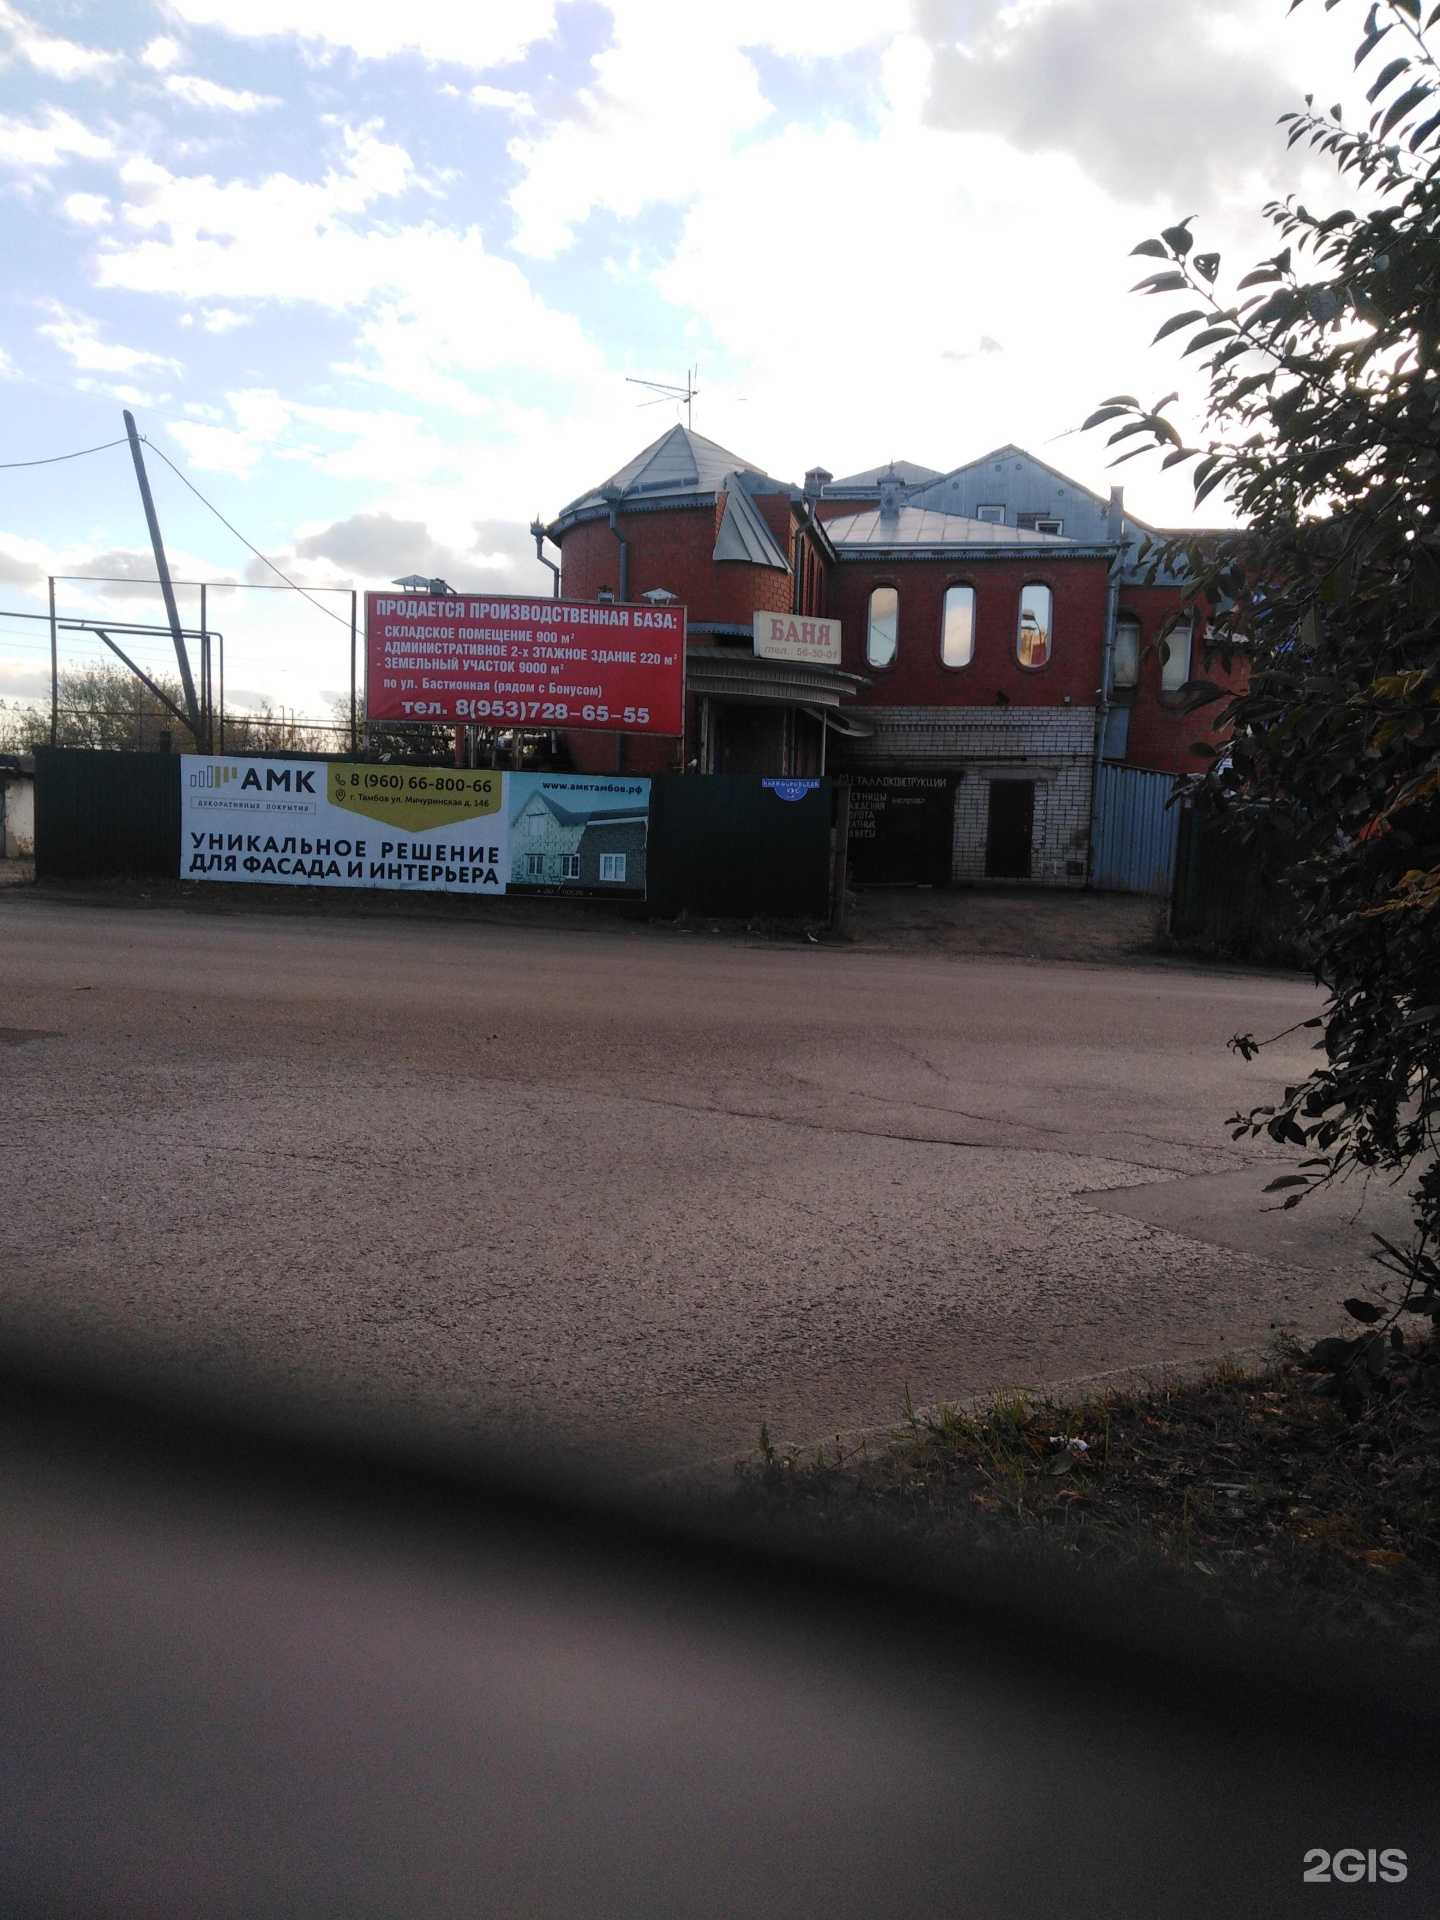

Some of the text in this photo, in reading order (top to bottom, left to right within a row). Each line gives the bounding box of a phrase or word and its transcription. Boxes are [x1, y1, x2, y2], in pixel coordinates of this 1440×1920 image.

[376, 599, 678, 630] ПРОДАЕТСЯ ПРОИЗВОДСТВЕННАЯ БАЗА:
[384, 625, 455, 639] СКЛАДСКОЕ
[458, 627, 533, 642] ПОМЕЩЕНИЕ
[536, 631, 558, 643] 900
[771, 619, 832, 645] БАНЯ
[384, 641, 507, 656] АДМИНИСТРАТИВНОЕ
[511, 647, 529, 657] 2-х
[532, 646, 588, 661] ЭТАЖНОЕ
[591, 650, 637, 664] ЗДАНИЕ
[639, 653, 661, 665] 220
[384, 657, 459, 671] ЗЕМЕЛЬНЫЙ
[463, 659, 515, 673] УЧАСТОК
[519, 662, 547, 674] 9000
[383, 677, 603, 698] по ул. Бастионная (рядом с Бонусом)
[401, 700, 448, 715] тел.
[240, 767, 317, 793] АМК
[350, 773, 492, 793] 8 (960) 66-800-66
[358, 793, 389, 803] Тамбов
[391, 795, 401, 805] ул.
[404, 796, 463, 808] Мичуринская
[190, 832, 499, 864] УНИКАЛЬНОЕ РЕШЕНИЕ
[188, 853, 499, 885] ДЛЯ ФАСАДА И ИНТЕРЬЕРА
